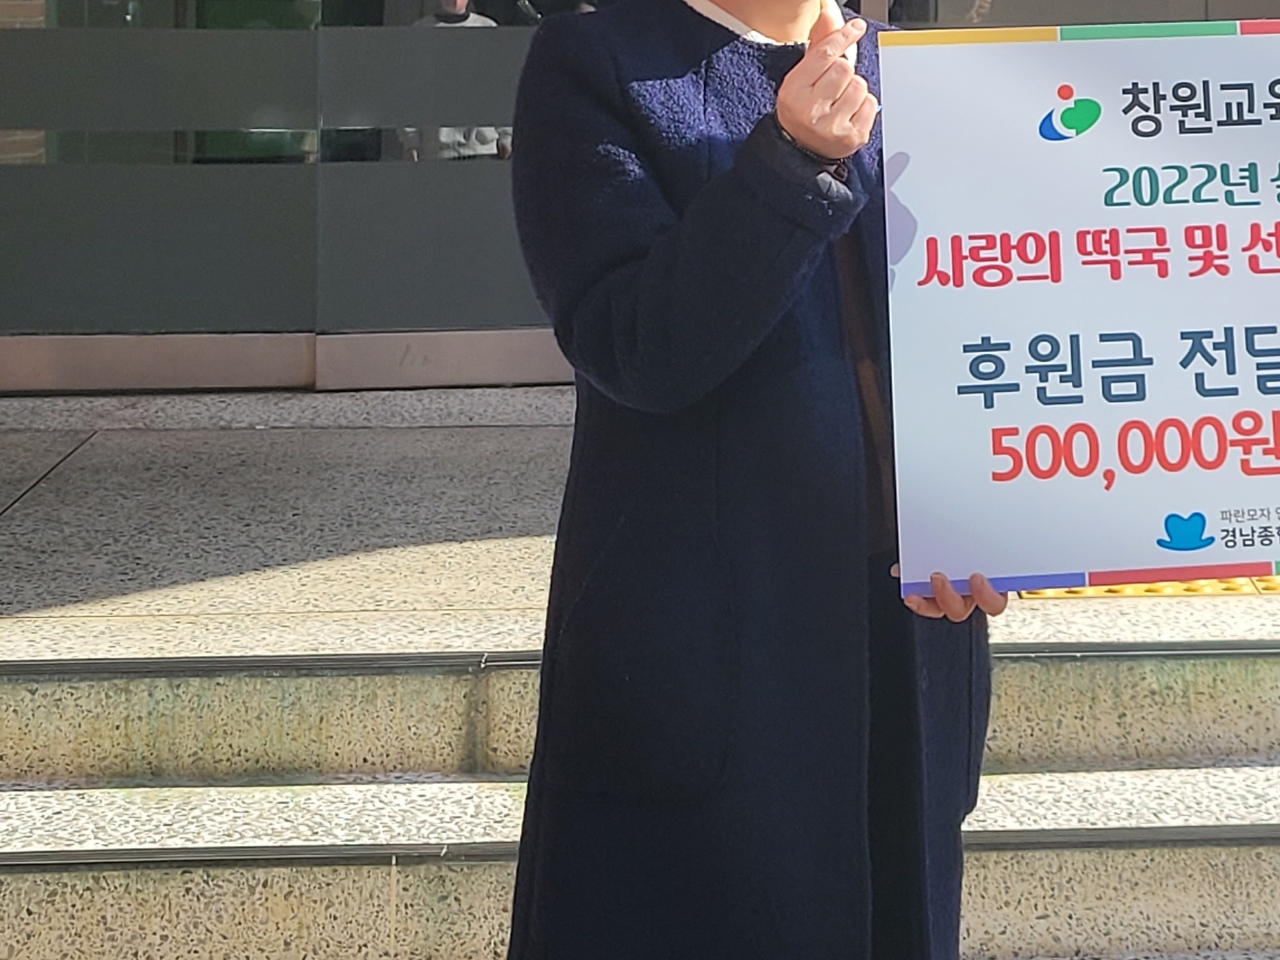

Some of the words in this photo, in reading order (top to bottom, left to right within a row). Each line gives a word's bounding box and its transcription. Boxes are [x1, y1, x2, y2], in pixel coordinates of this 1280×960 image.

[1102, 160, 1259, 207] 2022년
[916, 229, 1062, 289] 사랑의
[1077, 225, 1170, 280] 떡국
[1184, 222, 1231, 278] 및
[955, 333, 1155, 410] 후원금
[1220, 508, 1271, 524] 파란모자
